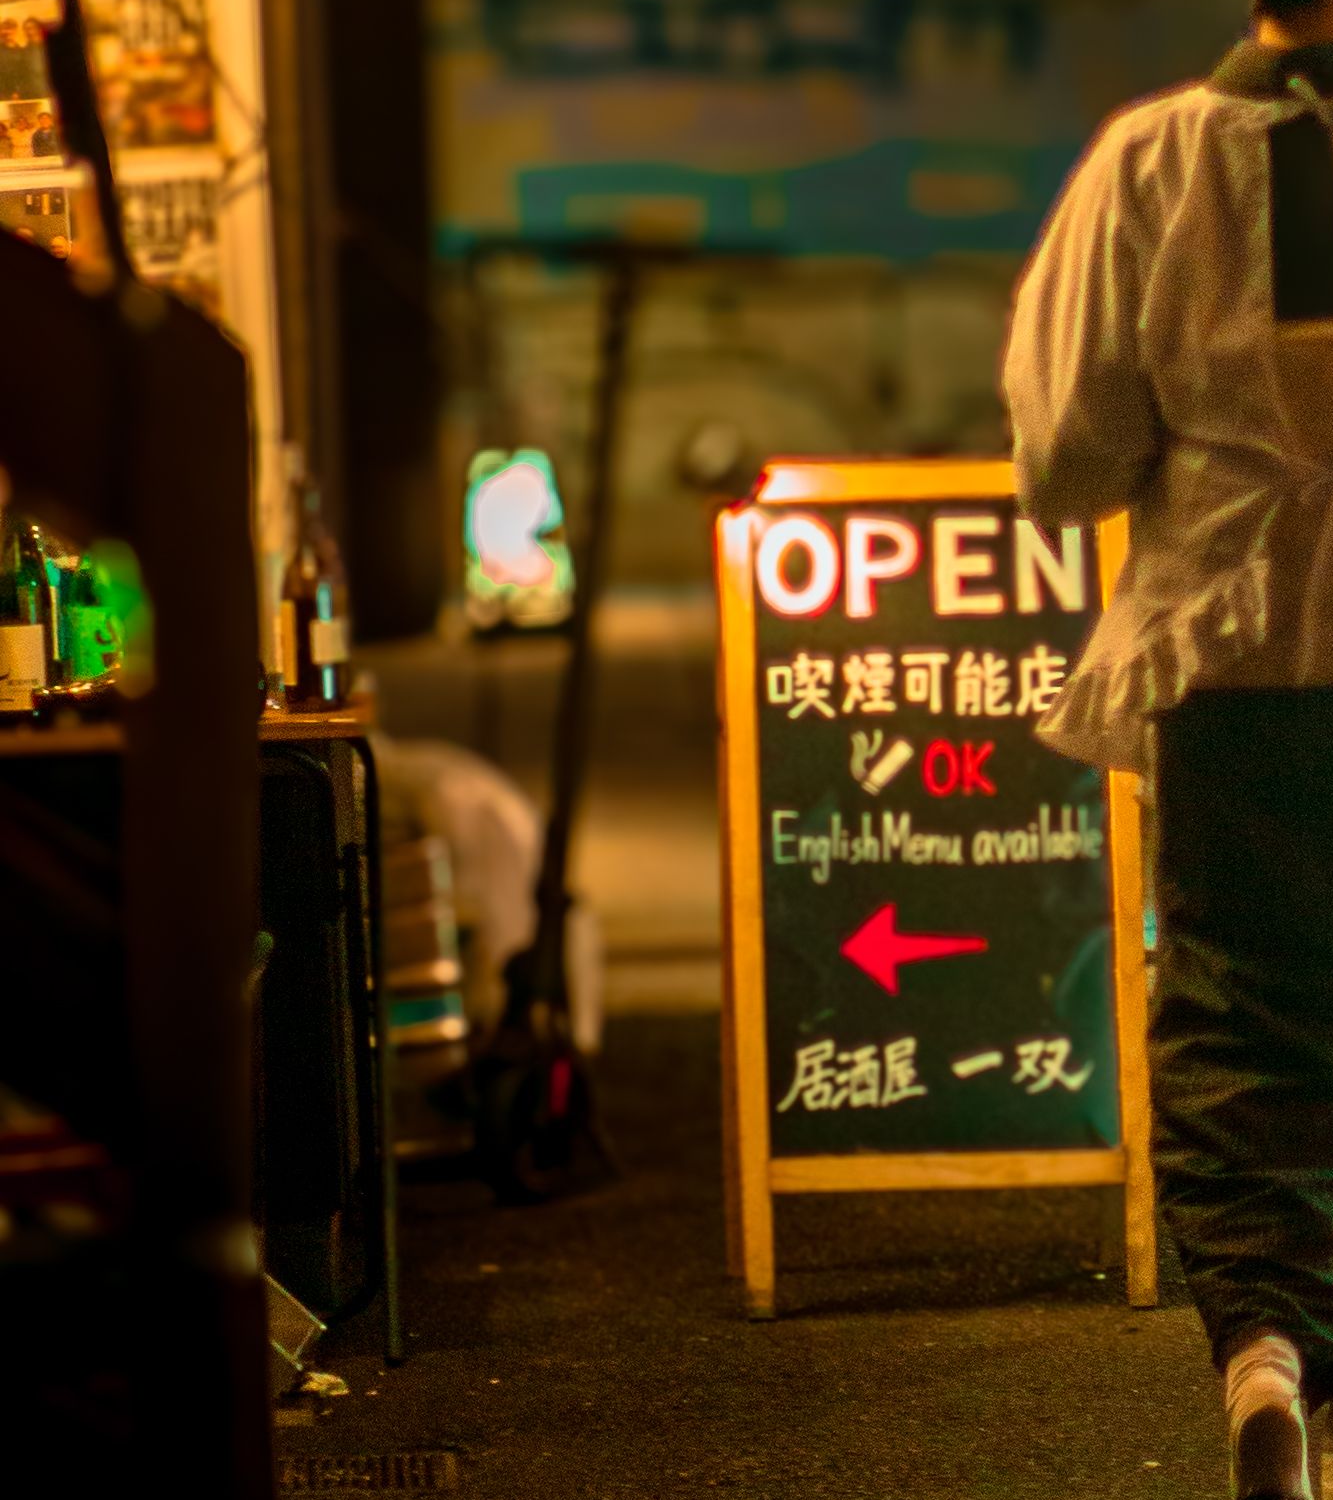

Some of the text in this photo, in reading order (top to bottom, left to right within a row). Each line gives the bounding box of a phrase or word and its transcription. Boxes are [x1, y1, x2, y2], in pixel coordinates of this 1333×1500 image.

[757, 514, 1086, 619] OPEN
[766, 644, 1068, 720] 喫煙可能店
[921, 737, 998, 798] OK
[771, 803, 1104, 885] English Menu available
[776, 1036, 1095, 1113] 居酒屋 一双
